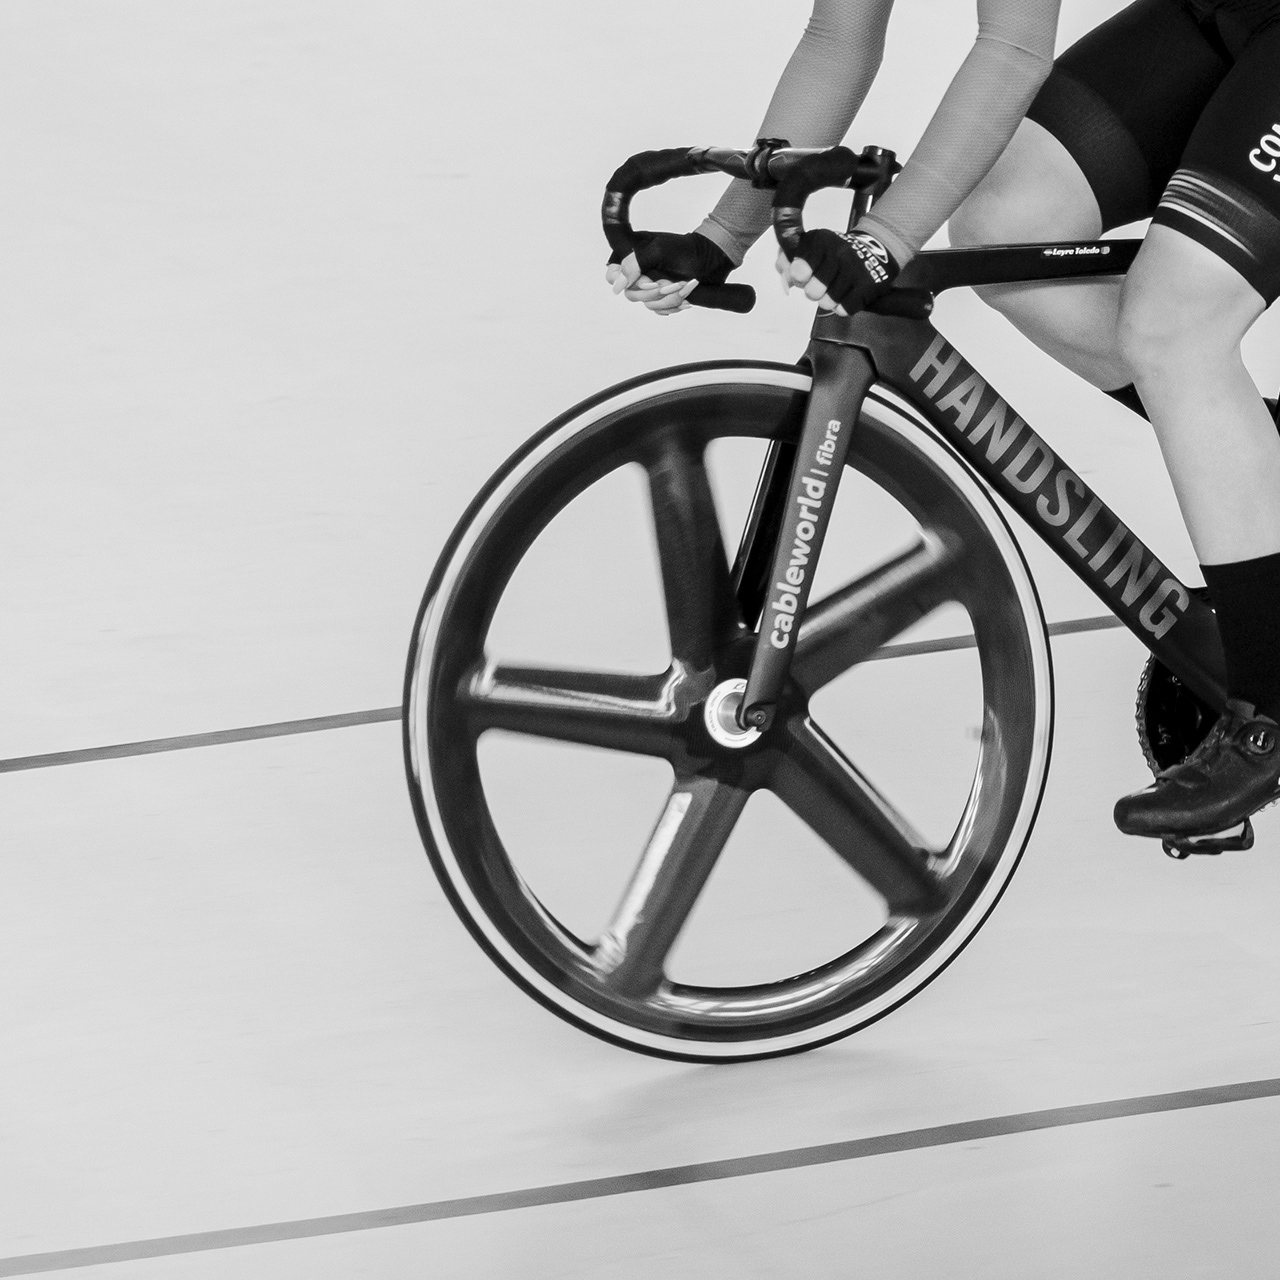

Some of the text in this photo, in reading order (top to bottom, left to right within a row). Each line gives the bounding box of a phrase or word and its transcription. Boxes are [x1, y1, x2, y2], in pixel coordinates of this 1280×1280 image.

[1075, 246, 1100, 255] Toledo
[770, 419, 841, 649] cableworld fibra
[908, 332, 1190, 640] HANDSLING
